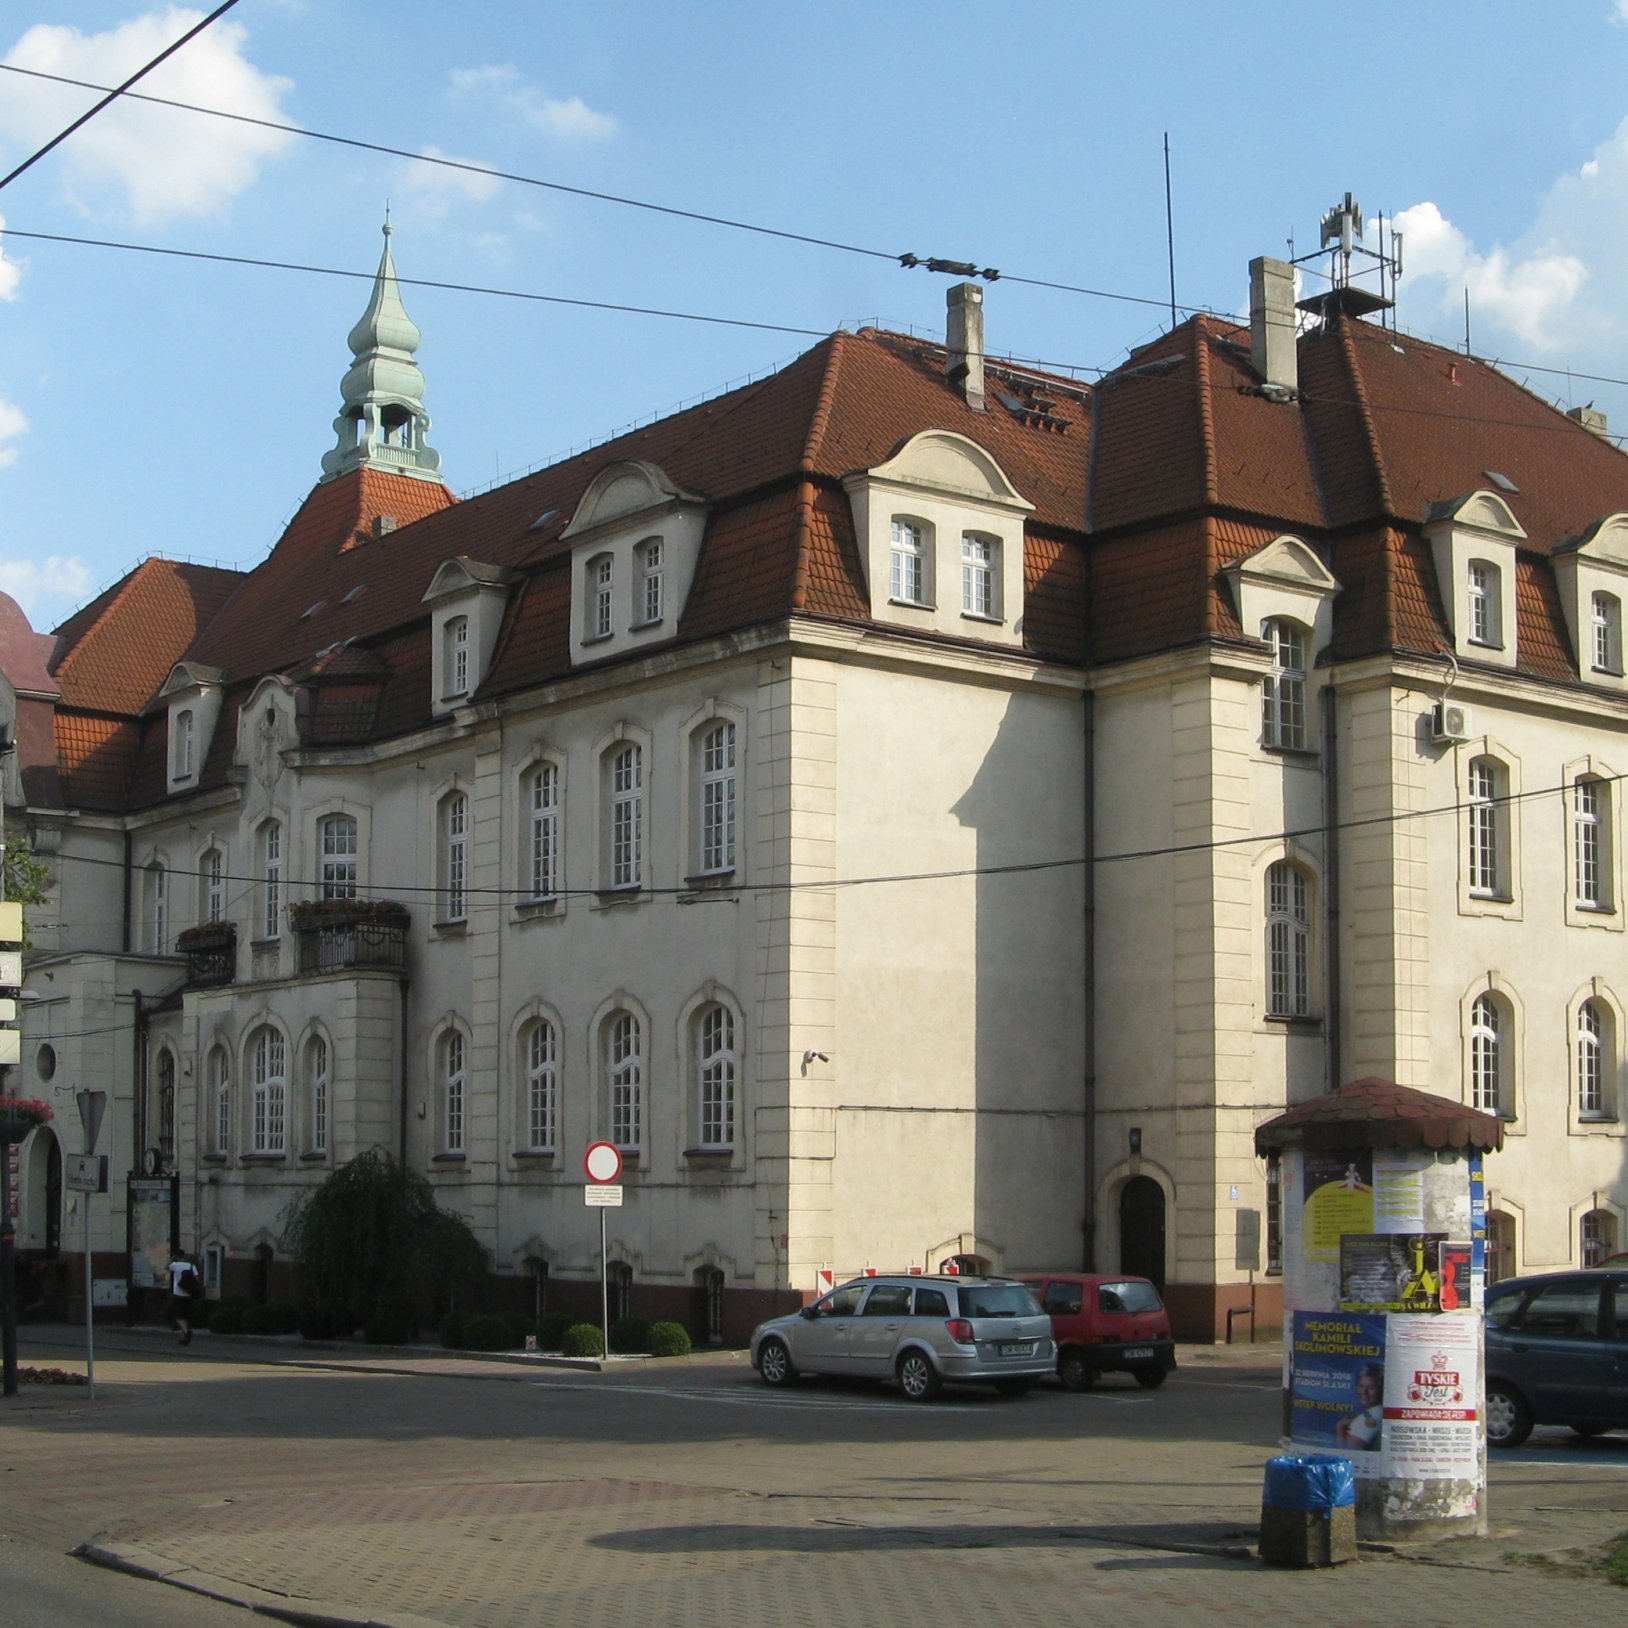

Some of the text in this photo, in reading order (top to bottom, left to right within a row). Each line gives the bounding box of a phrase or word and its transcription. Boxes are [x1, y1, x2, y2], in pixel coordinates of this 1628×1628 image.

[1304, 1321, 1364, 1334] MEMORIAŁ
[1312, 1332, 1352, 1344] KAMILI
[1418, 1372, 1457, 1385] TYSKIE
